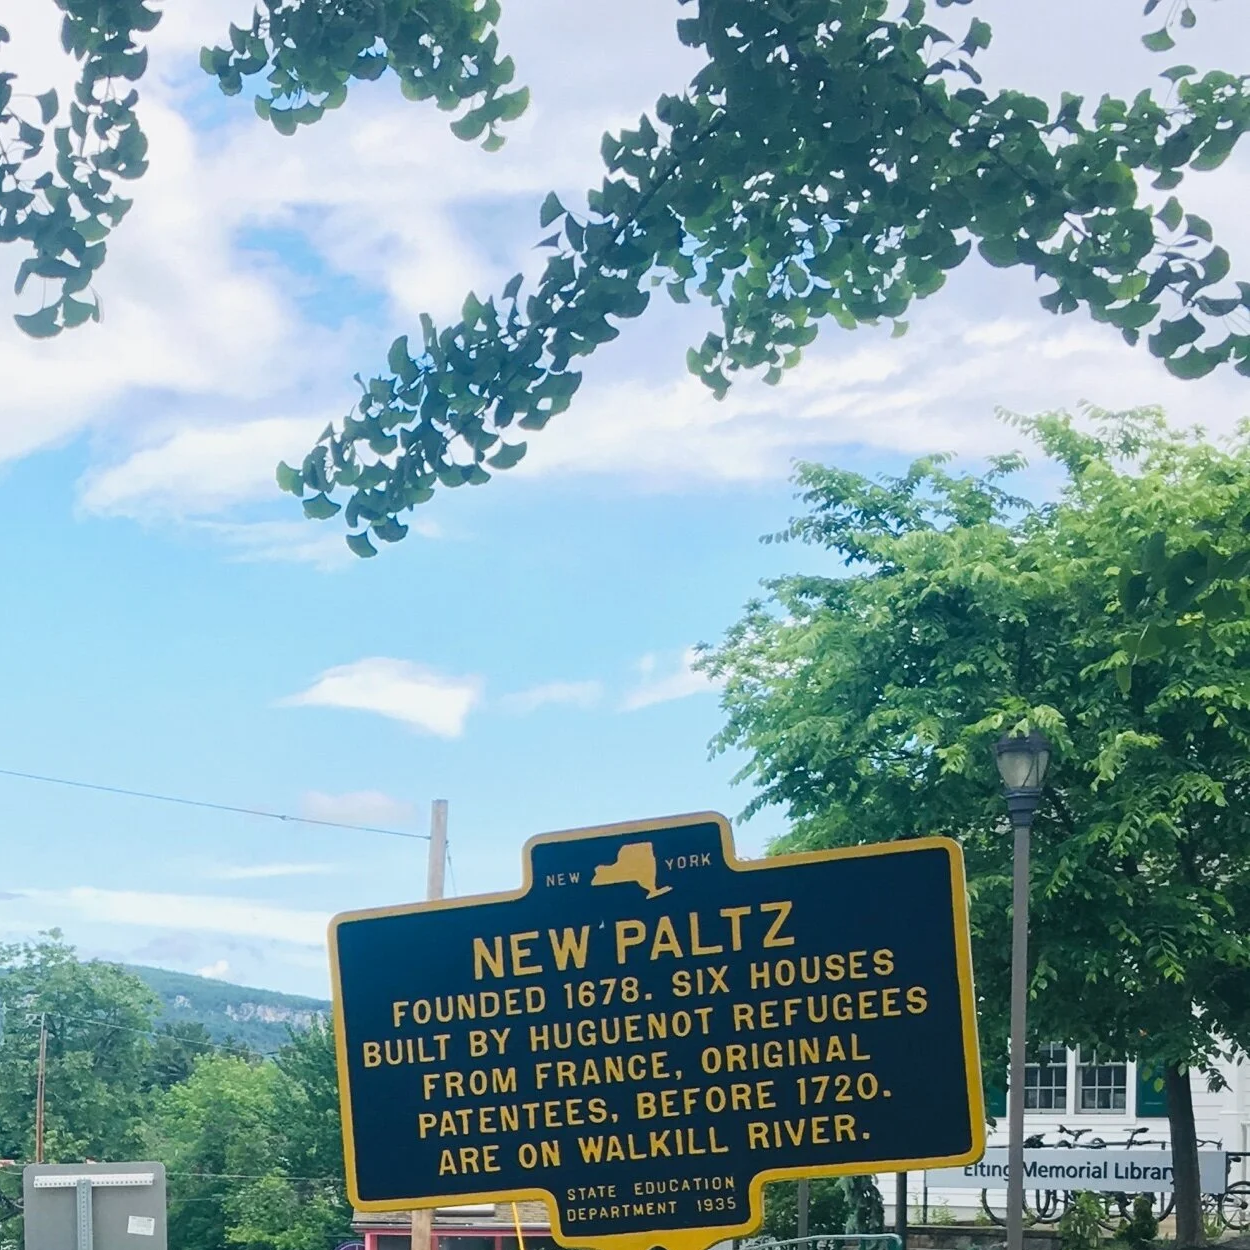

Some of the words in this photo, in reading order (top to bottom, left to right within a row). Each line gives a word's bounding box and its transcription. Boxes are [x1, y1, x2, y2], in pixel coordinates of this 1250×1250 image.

[546, 873, 580, 886] NEW
[665, 853, 711, 869] YORK
[474, 926, 589, 979] NEW
[616, 901, 794, 963] PALTZ
[394, 987, 545, 1027] FOUNDED
[565, 977, 651, 1008] 1678.
[673, 966, 729, 996] SIX
[751, 949, 893, 989] HOUSES
[364, 1035, 449, 1067] BUILT
[470, 1028, 509, 1056] BY
[530, 1008, 712, 1051] HUGUENOT
[734, 987, 927, 1031] REFUGEES
[424, 1068, 516, 1099] FROM
[536, 1052, 681, 1089] FRANCE,
[702, 1034, 870, 1073] ORIGINAL
[419, 1099, 617, 1138] PATENTEES,
[637, 1081, 775, 1118] BEFORE
[797, 1073, 890, 1104] 1720.
[440, 1145, 500, 1175] ARE
[519, 1140, 560, 1168] ON
[578, 1127, 728, 1163] WALKILL
[749, 1115, 869, 1149] RIVER.
[964, 1162, 1010, 1181] Elting
[1022, 1161, 1107, 1179] Memorial
[568, 1186, 614, 1200] STATE
[635, 1177, 733, 1195] EDUCATION
[568, 1202, 675, 1221] DEPARTMENT
[698, 1198, 735, 1211] 1935
